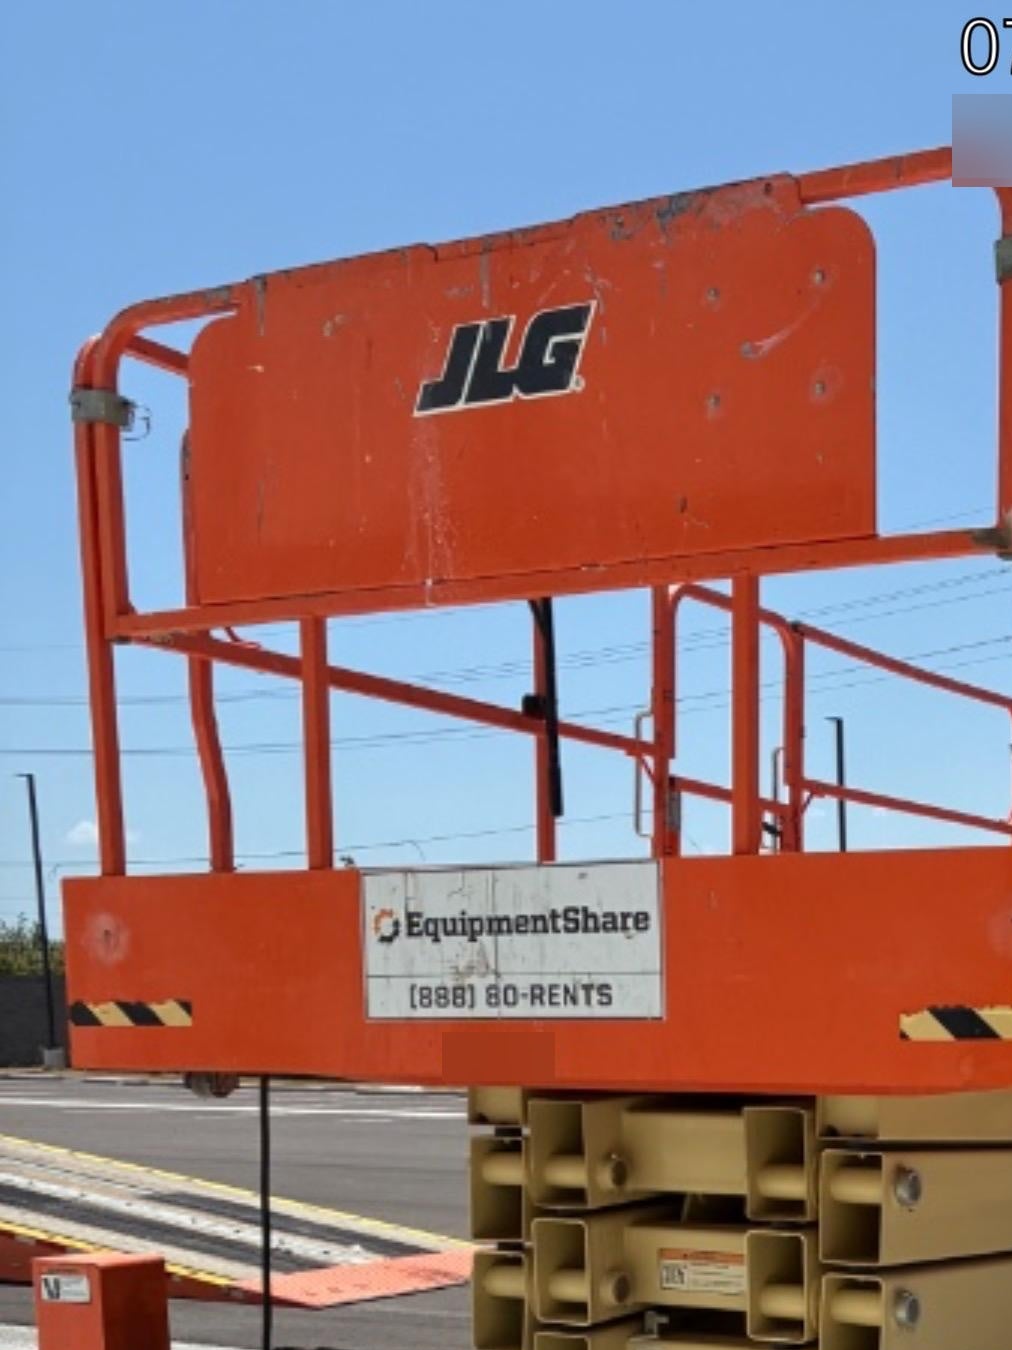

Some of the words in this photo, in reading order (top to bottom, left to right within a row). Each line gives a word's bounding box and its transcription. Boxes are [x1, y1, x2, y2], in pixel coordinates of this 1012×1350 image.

[412, 300, 597, 416] JLG
[406, 906, 650, 942] EquipmentShare
[485, 983, 613, 1008] 80-RENTS
